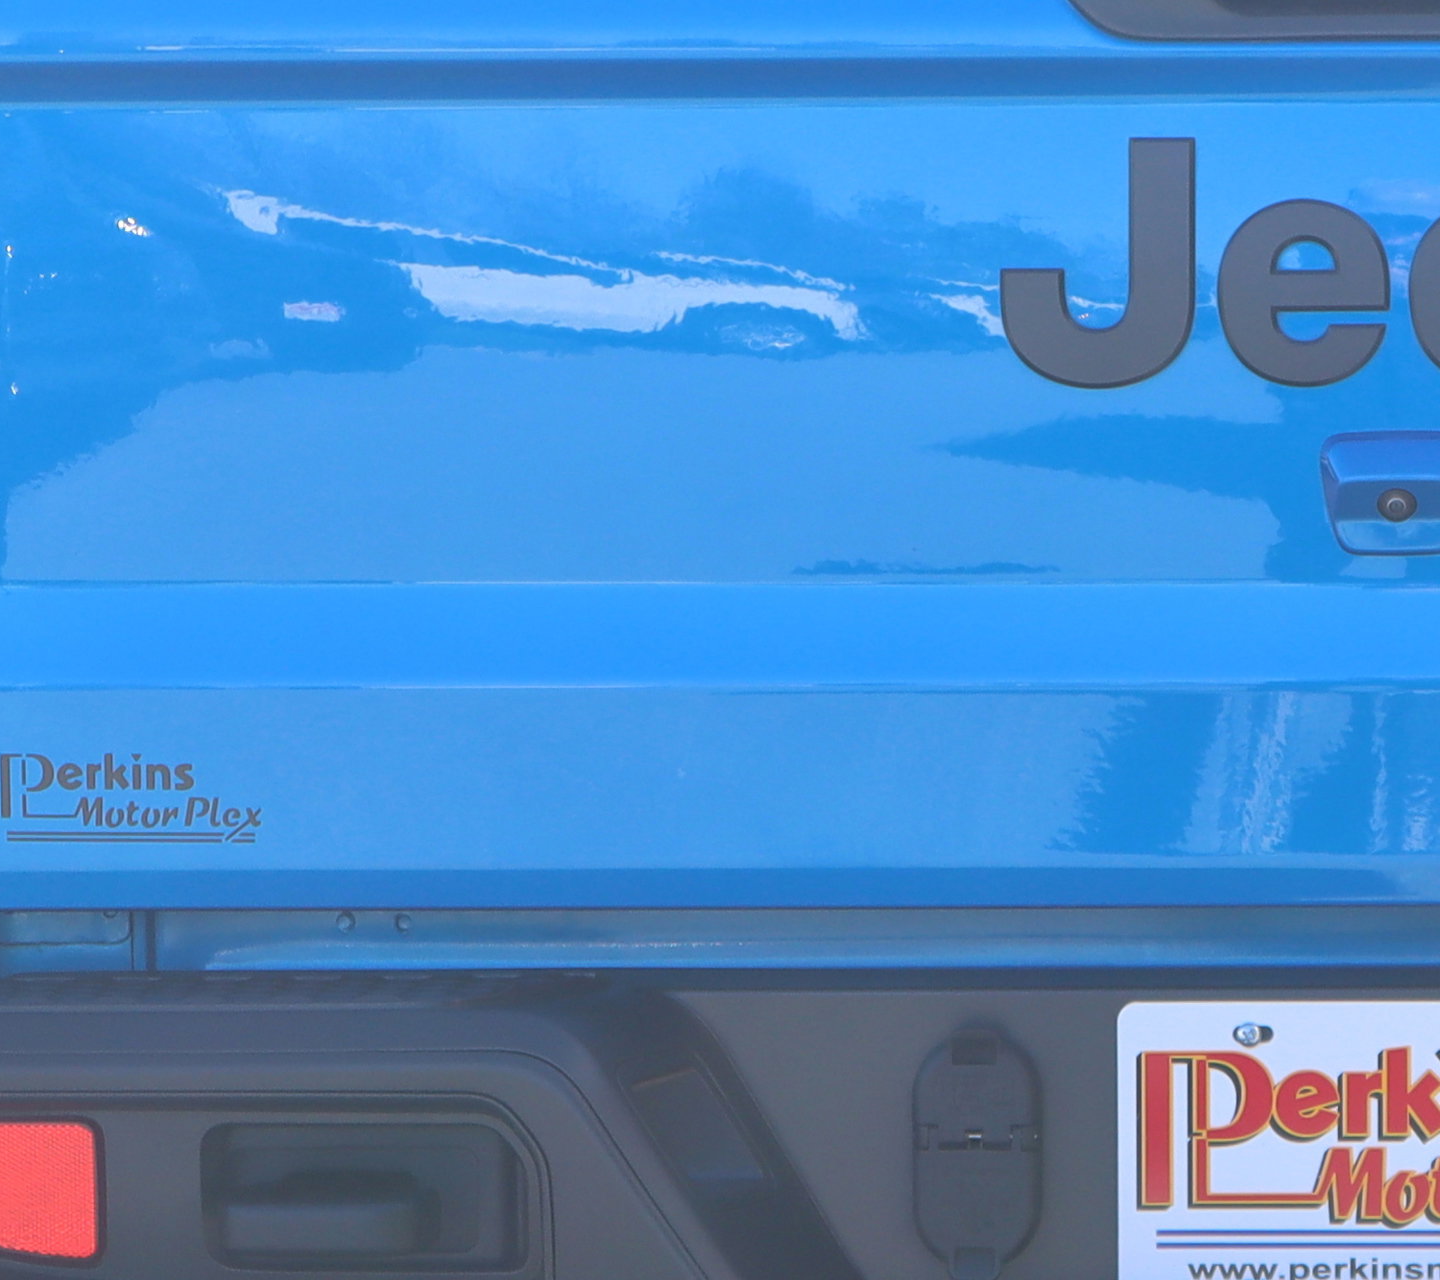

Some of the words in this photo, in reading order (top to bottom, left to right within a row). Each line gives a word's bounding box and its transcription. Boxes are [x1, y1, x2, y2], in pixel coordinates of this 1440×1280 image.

[0, 753, 195, 818] Perkins
[75, 796, 179, 829] Motor
[184, 797, 263, 841] Plex
